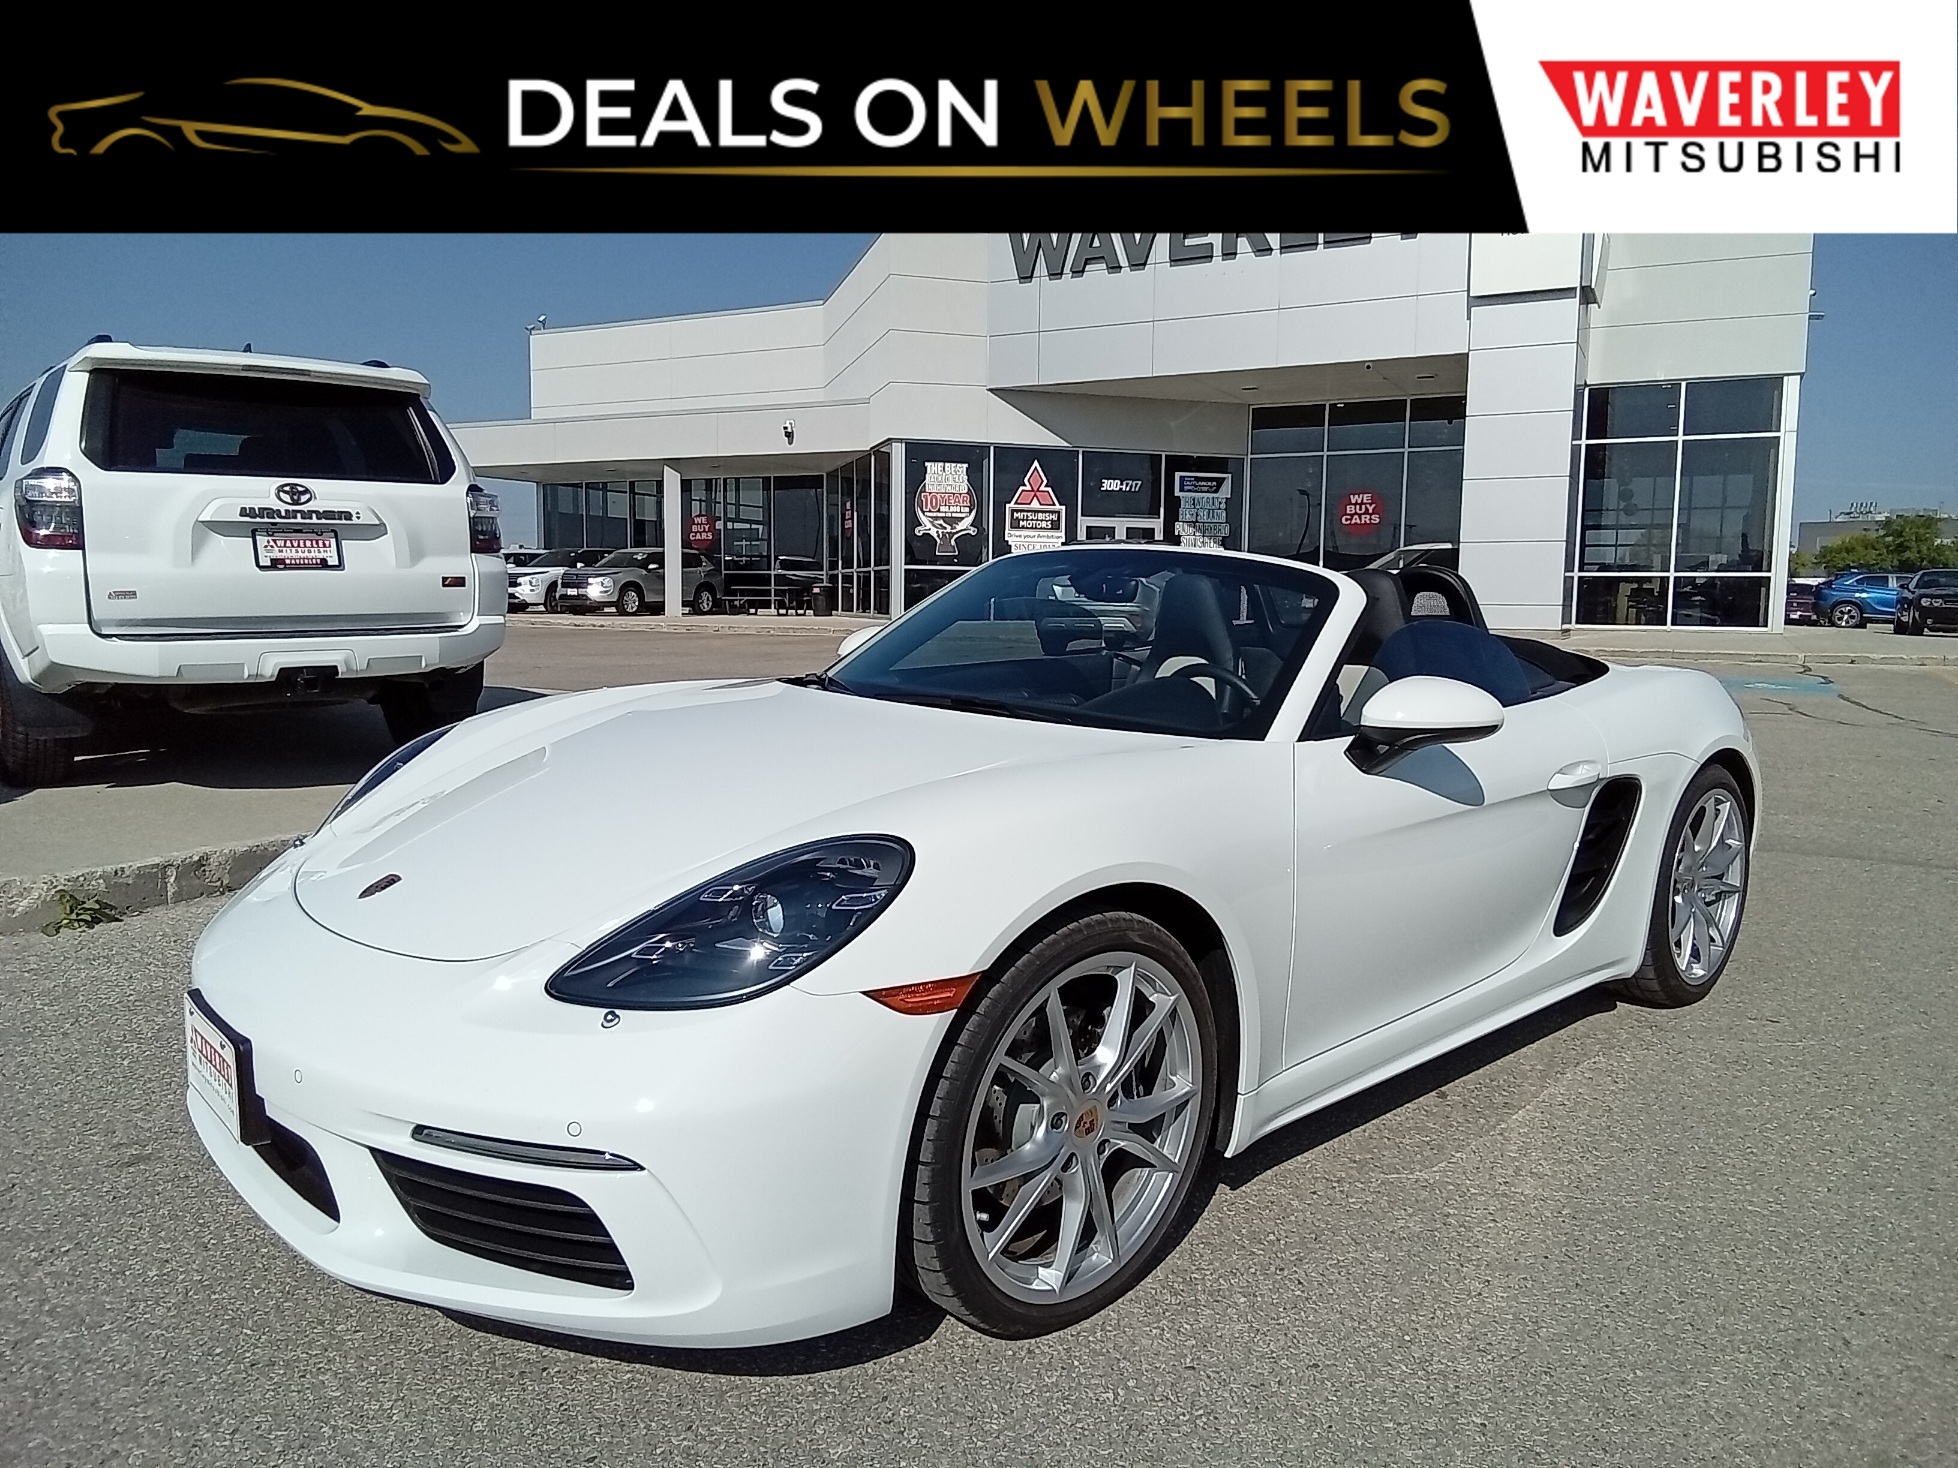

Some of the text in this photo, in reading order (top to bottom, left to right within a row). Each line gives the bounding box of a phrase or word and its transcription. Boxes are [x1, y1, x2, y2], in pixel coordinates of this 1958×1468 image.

[925, 462, 968, 475] THE BEST
[1100, 479, 1142, 491] 300-1717
[922, 493, 970, 511] 10 YEAR
[1350, 494, 1372, 504] WE
[1346, 504, 1376, 514] BUY
[1013, 512, 1058, 520] MITSUBISHI
[1179, 508, 1197, 521] BEST
[694, 516, 708, 524] WE
[1019, 520, 1052, 528] MOTORS
[1341, 515, 1380, 524] CARS
[691, 524, 710, 532] BUY
[689, 532, 713, 541] CARS
[275, 539, 331, 548] WAVERLEY
